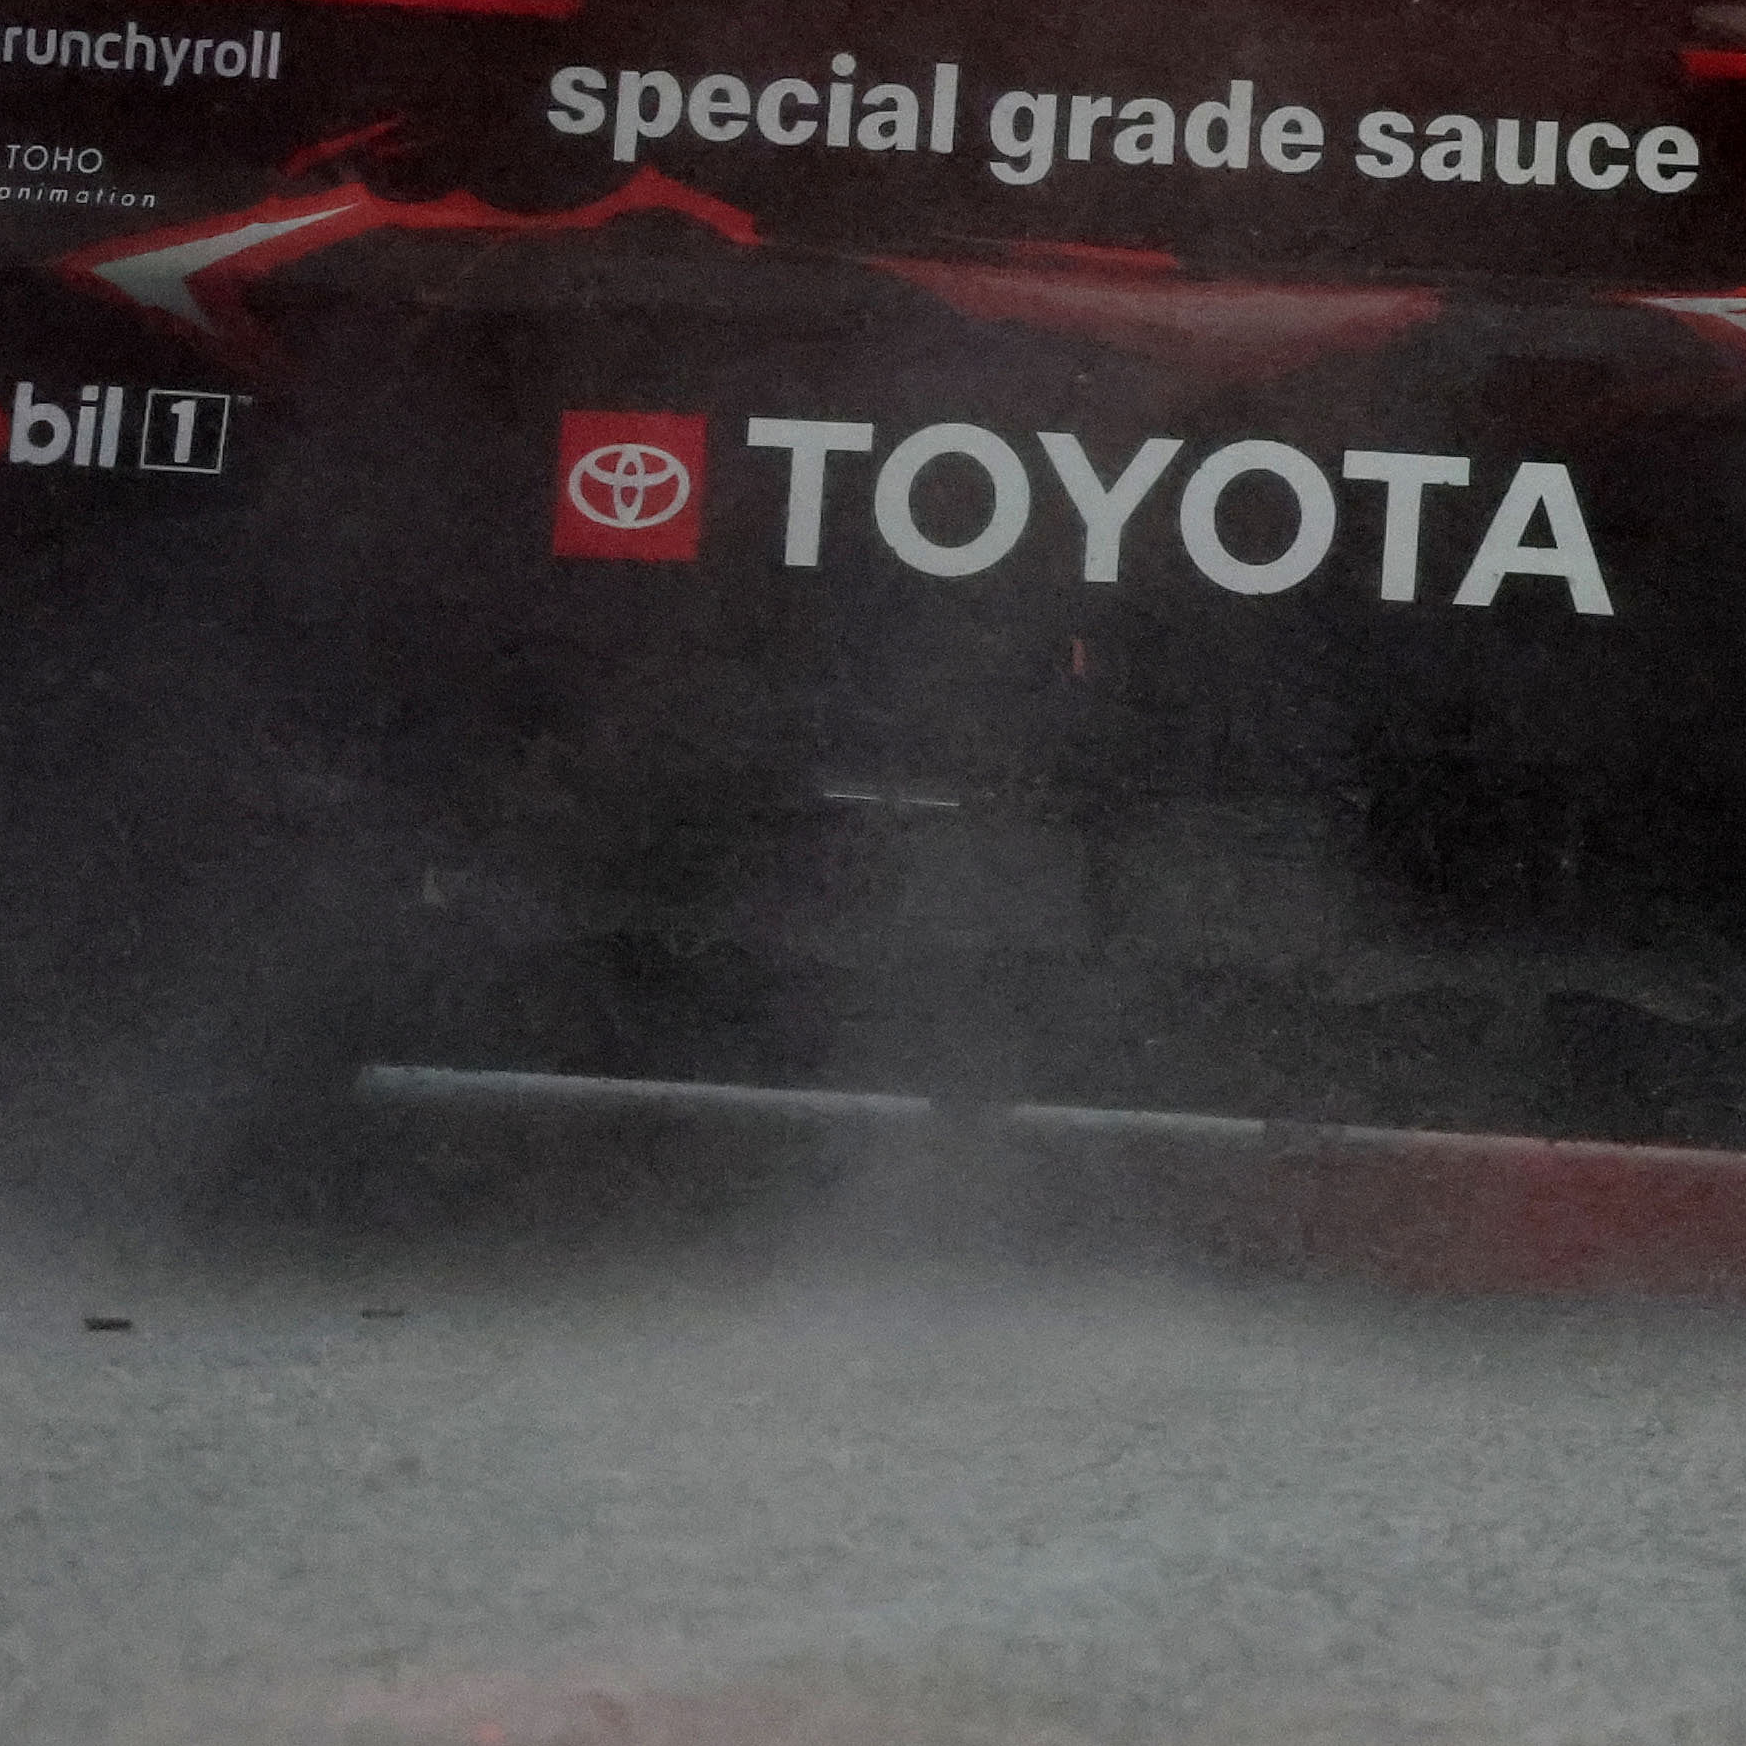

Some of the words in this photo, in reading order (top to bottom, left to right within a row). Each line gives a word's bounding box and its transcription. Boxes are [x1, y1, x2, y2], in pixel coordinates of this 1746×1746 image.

[5, 143, 103, 174] TOHO
[547, 54, 960, 162] special
[987, 79, 1325, 186] grade
[1354, 110, 1700, 194] sauce
[745, 415, 1615, 617] TOYOTA
